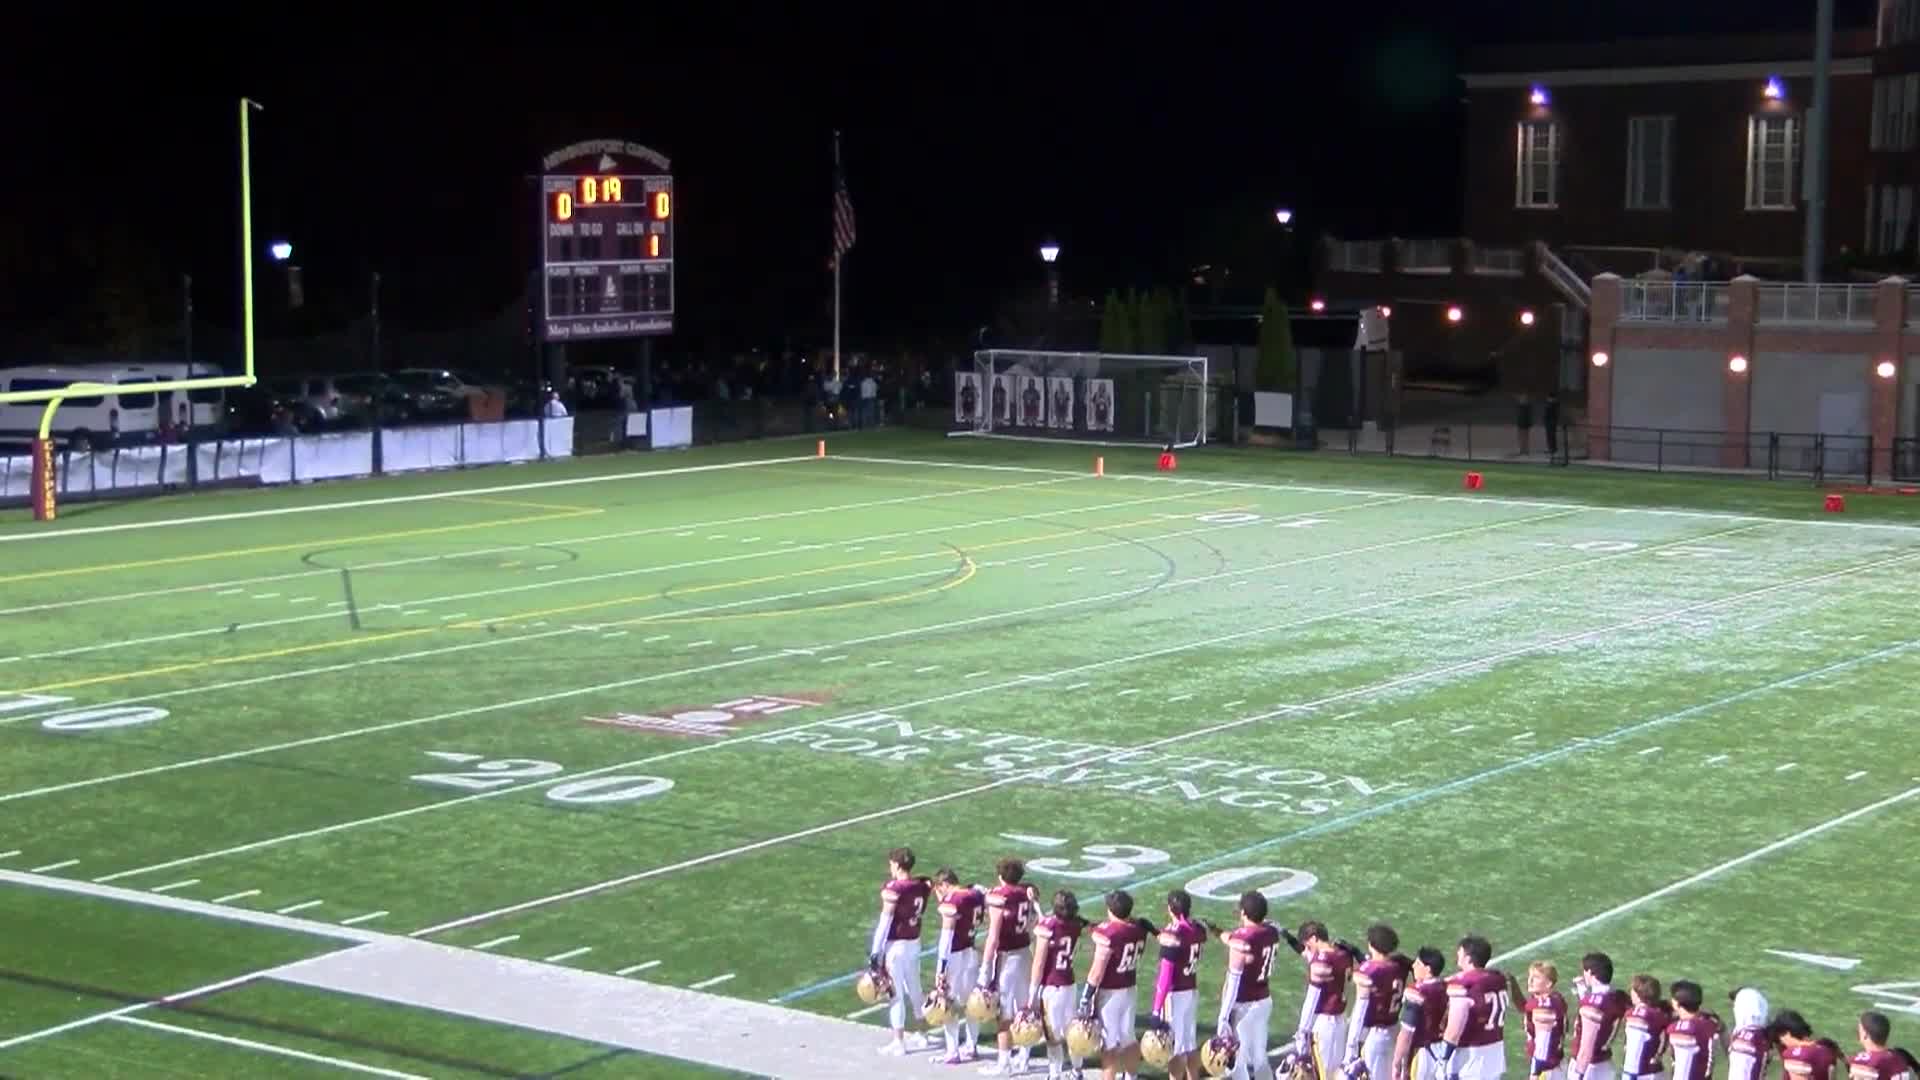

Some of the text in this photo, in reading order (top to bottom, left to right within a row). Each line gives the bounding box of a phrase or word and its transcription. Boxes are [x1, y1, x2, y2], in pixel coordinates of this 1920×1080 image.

[557, 193, 572, 219] 0
[656, 193, 669, 218] 0
[651, 235, 659, 256] 1
[751, 731, 931, 761] FOR
